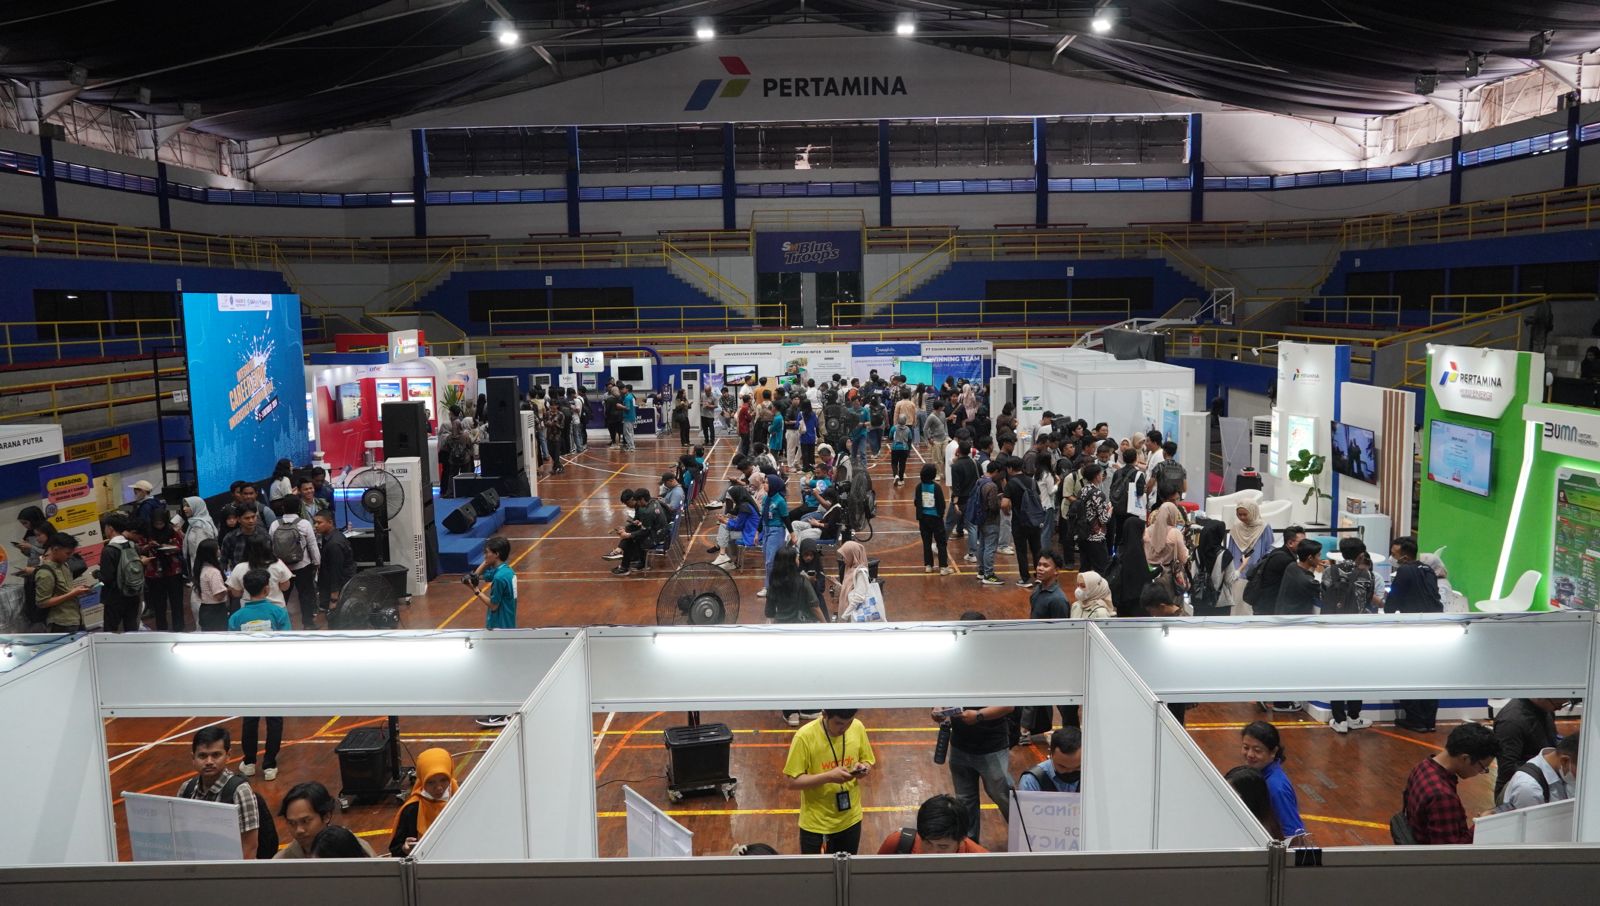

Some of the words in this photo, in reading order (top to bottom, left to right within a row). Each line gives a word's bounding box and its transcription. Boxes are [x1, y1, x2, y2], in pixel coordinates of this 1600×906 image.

[763, 76, 908, 97] PERTAMINA
[784, 248, 840, 265] Troops
[575, 356, 595, 367] tugu
[1460, 373, 1502, 387] PERTAMINA
[22, 436, 44, 445] PUTRA
[57, 477, 82, 487] REASONS
[821, 756, 854, 769] wodr
